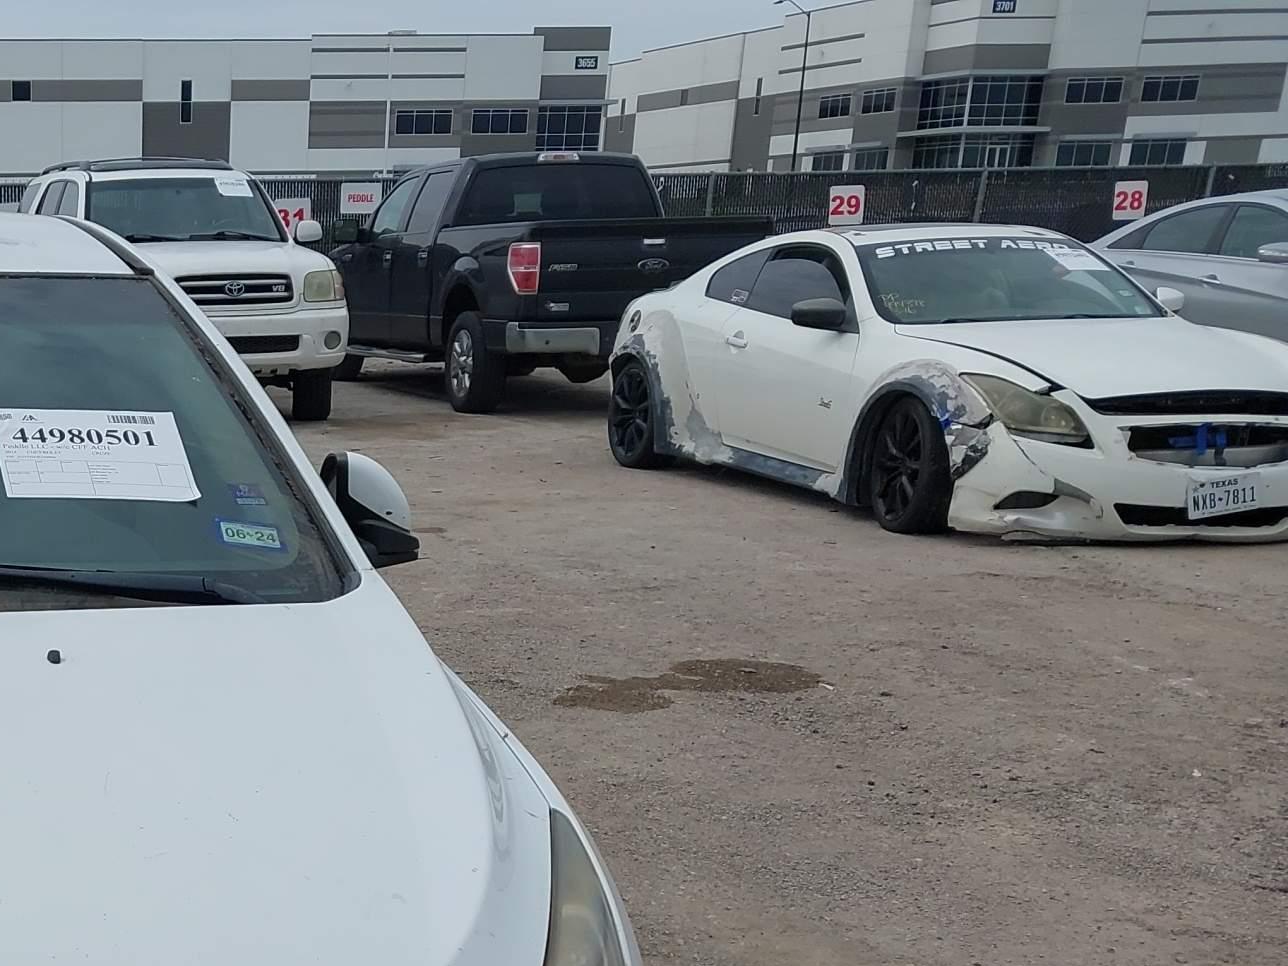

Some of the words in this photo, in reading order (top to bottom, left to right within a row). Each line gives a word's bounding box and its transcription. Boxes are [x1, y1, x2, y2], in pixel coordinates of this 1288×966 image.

[996, 1, 1013, 11] 3701
[577, 58, 596, 67] 3655
[347, 193, 374, 203] PEDDLE
[831, 195, 861, 216] 29
[1115, 191, 1143, 210] 28
[875, 240, 988, 260] STREET
[12, 427, 158, 447] 44980501
[1210, 478, 1238, 488] TEXAS
[1192, 485, 1256, 512] NXB-7811
